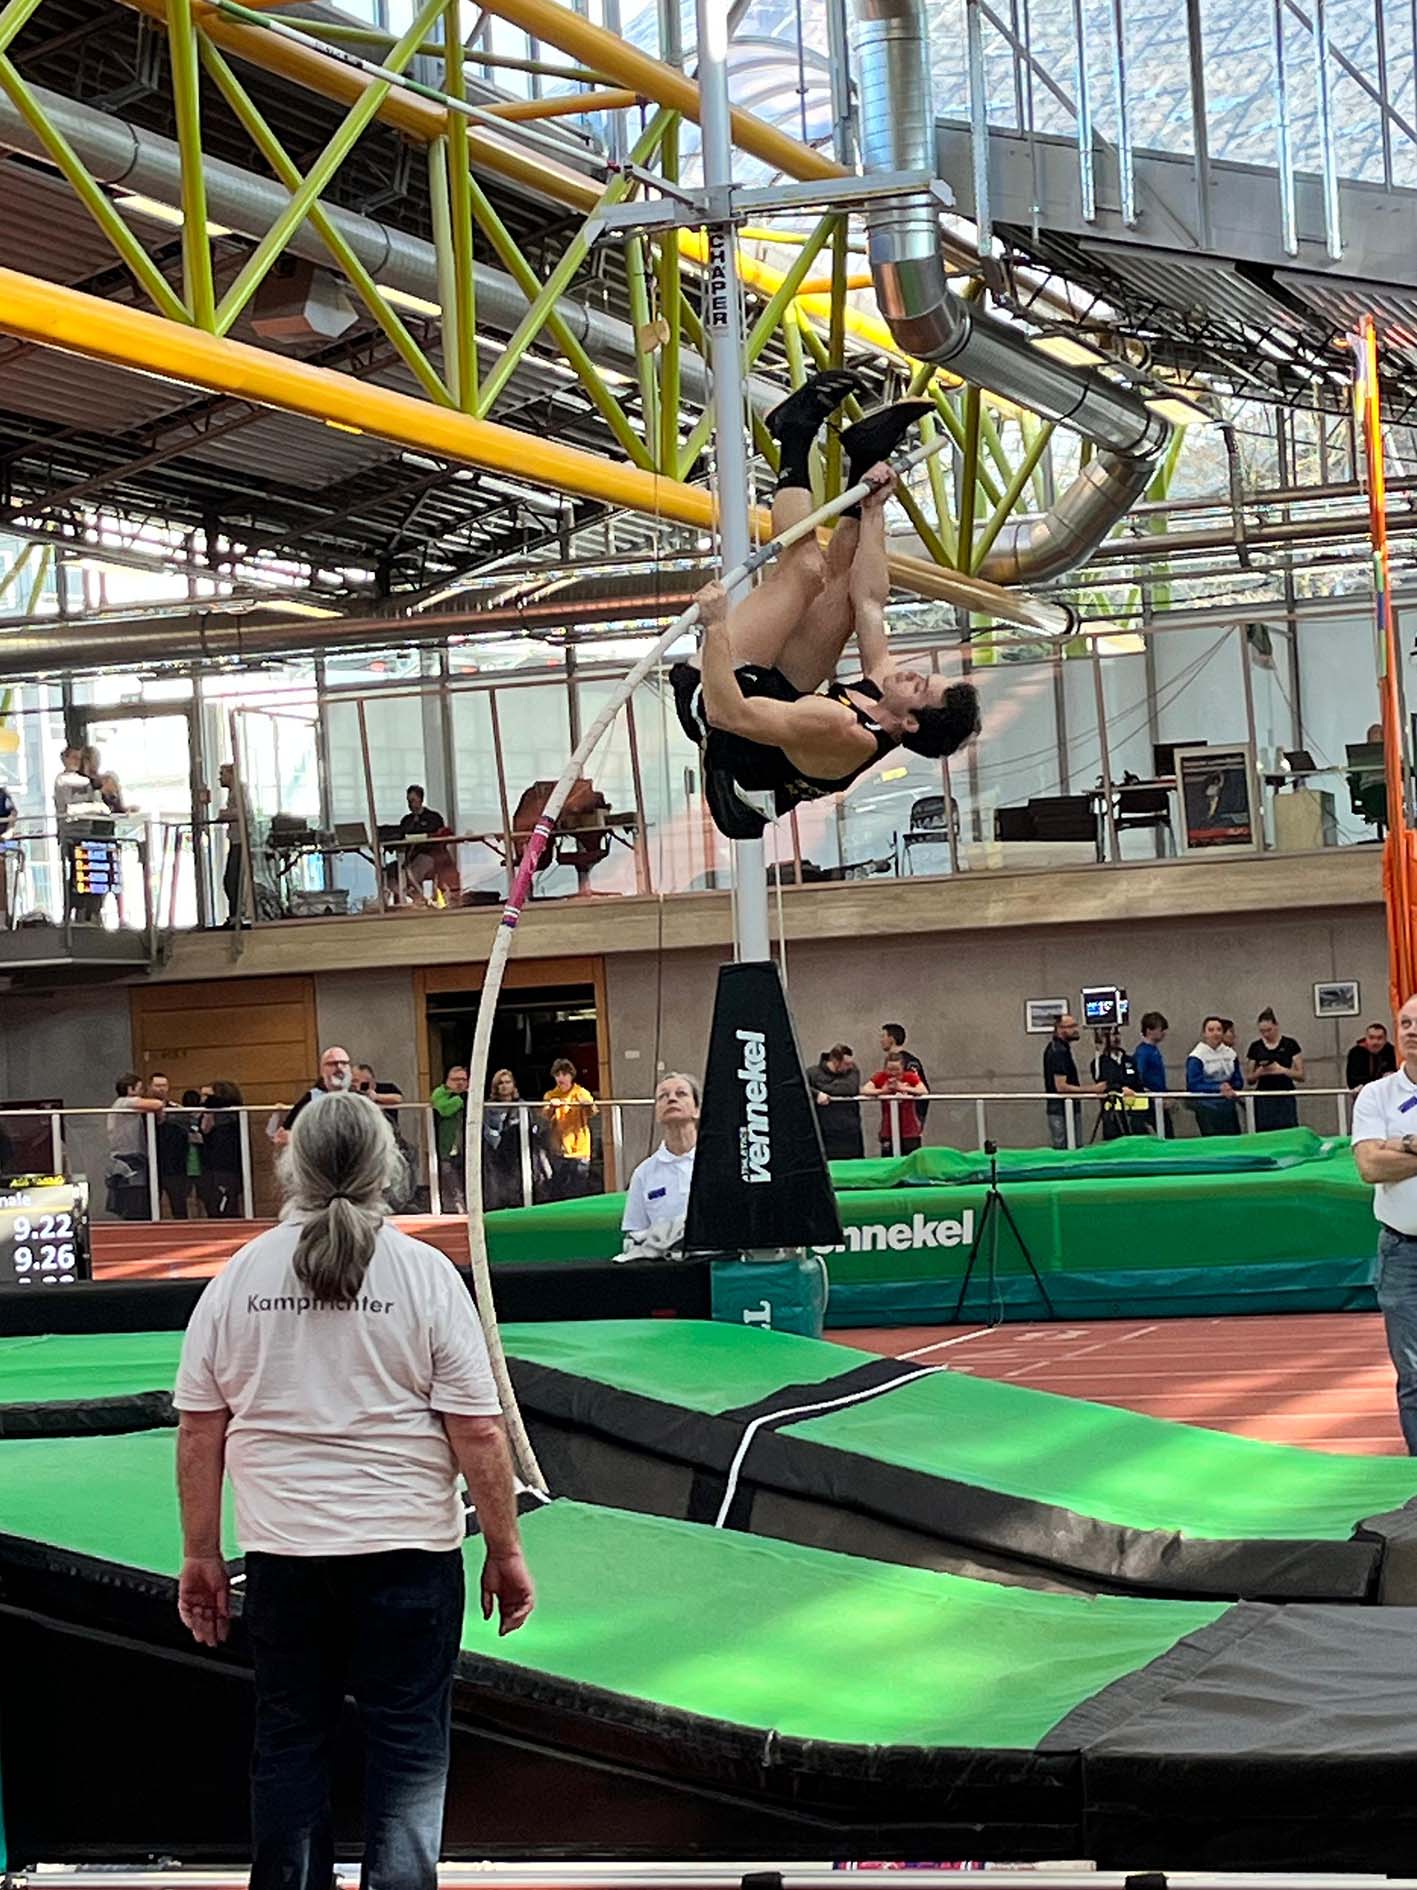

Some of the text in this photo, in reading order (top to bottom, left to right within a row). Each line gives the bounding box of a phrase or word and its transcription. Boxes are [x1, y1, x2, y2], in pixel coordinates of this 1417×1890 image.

[736, 1029, 772, 1183] vennekel
[14, 1214, 74, 1241] 9.22
[812, 1209, 974, 1254] nnekel
[14, 1243, 75, 1272] 9.26
